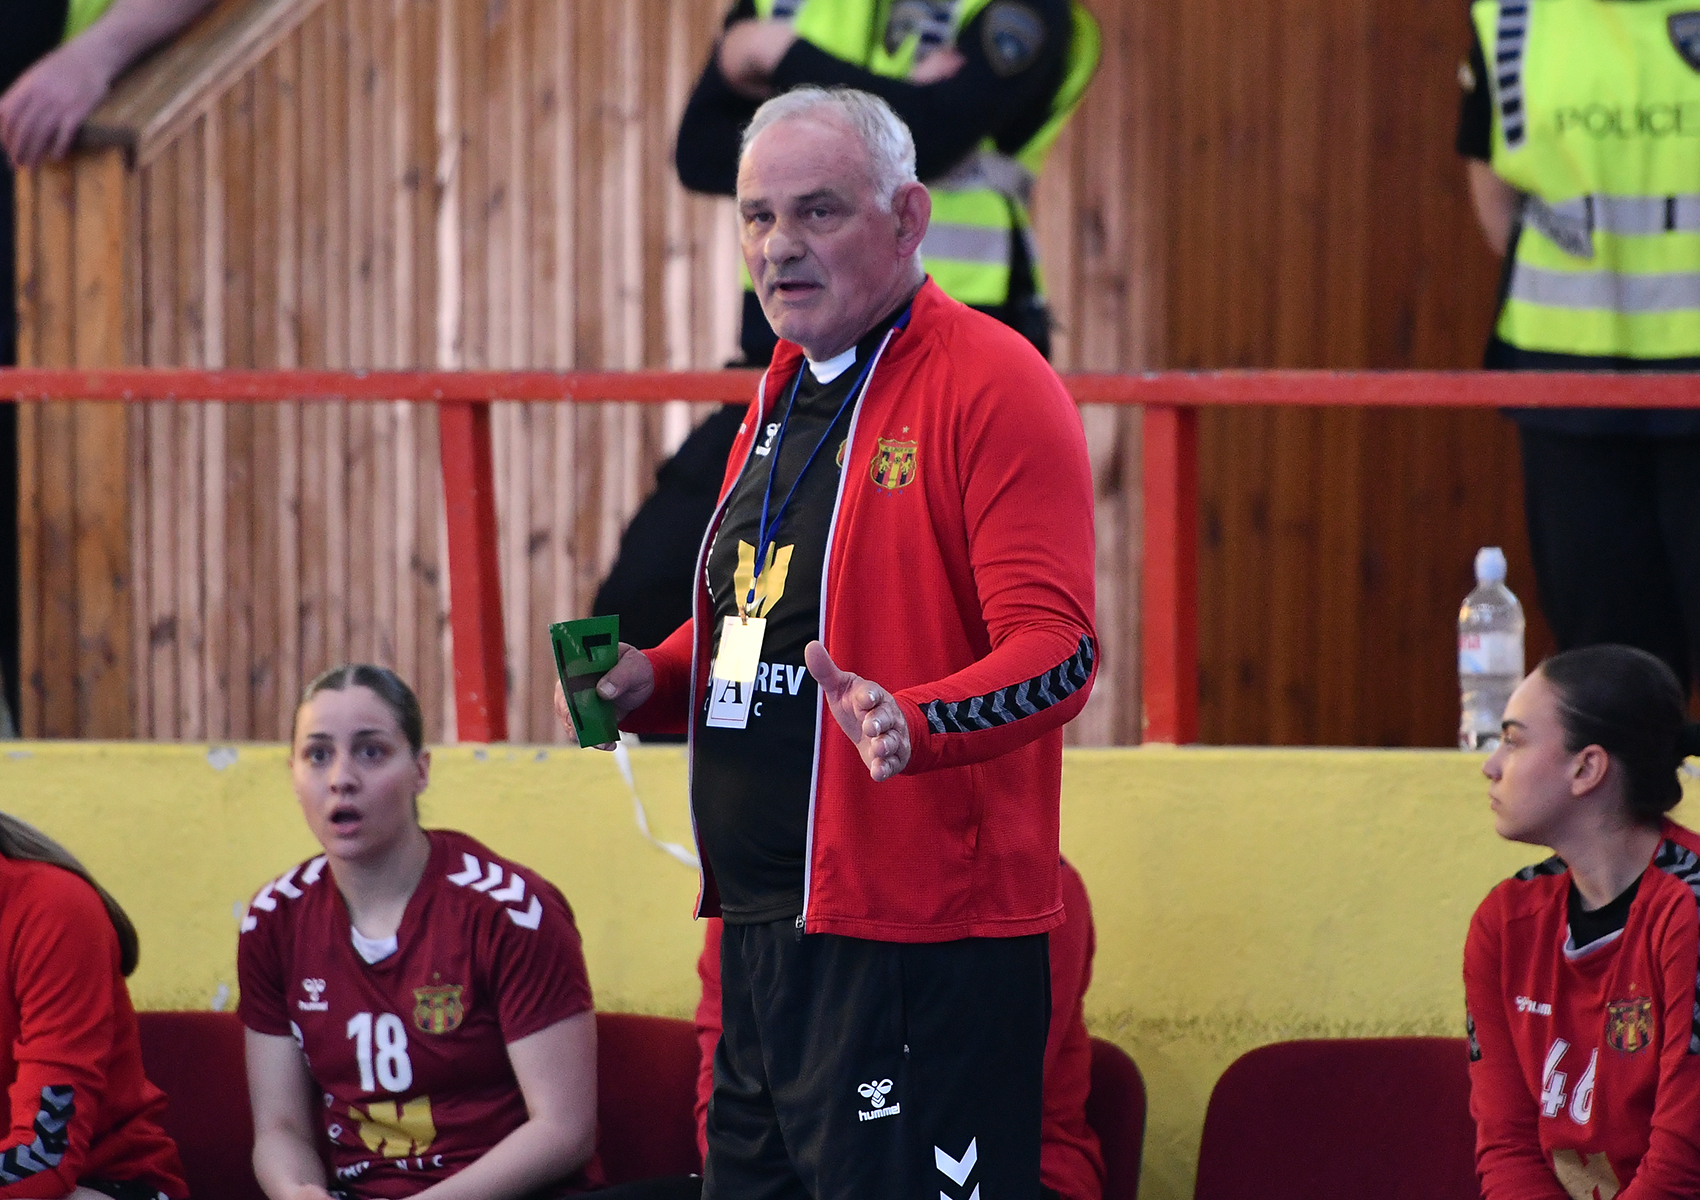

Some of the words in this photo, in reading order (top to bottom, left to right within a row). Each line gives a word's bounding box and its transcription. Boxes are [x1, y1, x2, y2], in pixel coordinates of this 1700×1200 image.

[1554, 102, 1700, 140] POLICE
[347, 1012, 413, 1092] 18
[1541, 1037, 1598, 1125] 46
[858, 1102, 900, 1122] hummel
